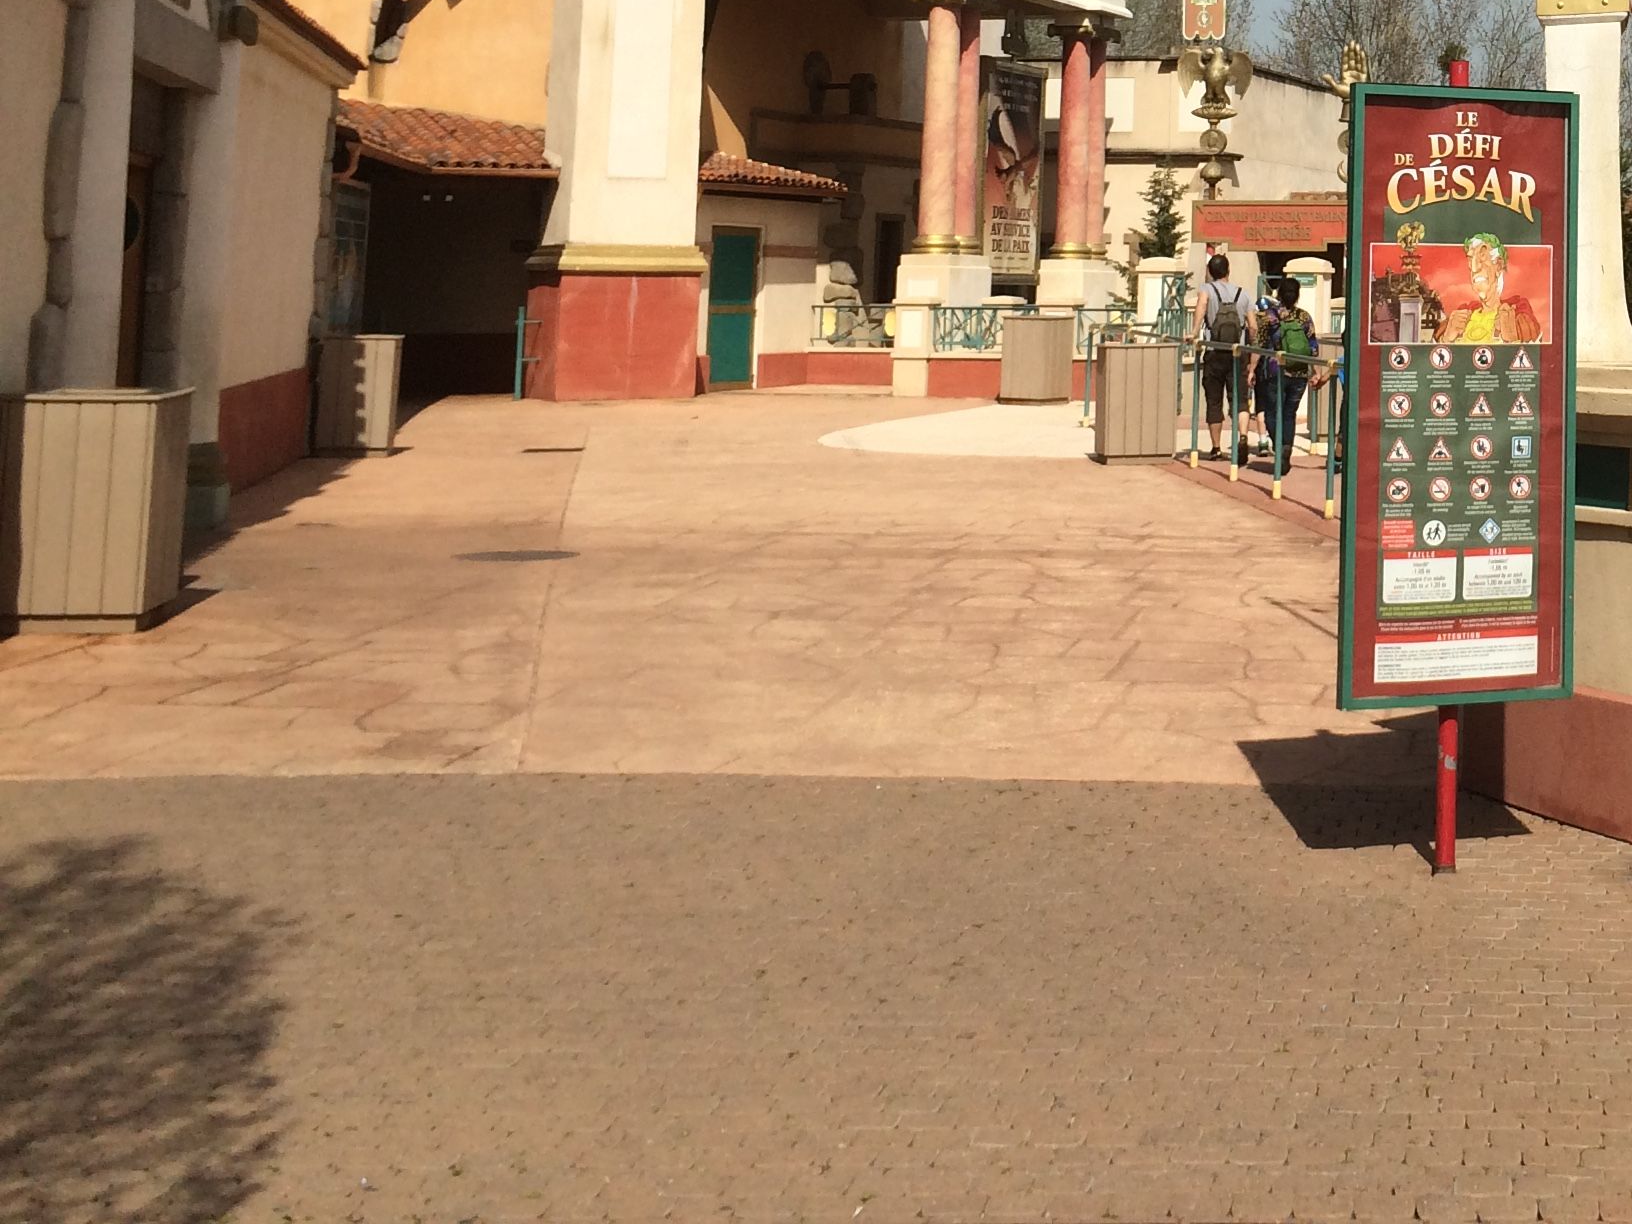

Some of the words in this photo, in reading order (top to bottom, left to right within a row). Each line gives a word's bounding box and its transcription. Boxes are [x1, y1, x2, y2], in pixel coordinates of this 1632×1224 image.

[1456, 111, 1479, 127] LE
[1428, 128, 1502, 161] DÉFI
[1394, 153, 1415, 166] DE
[1386, 158, 1536, 223] CÉSAR
